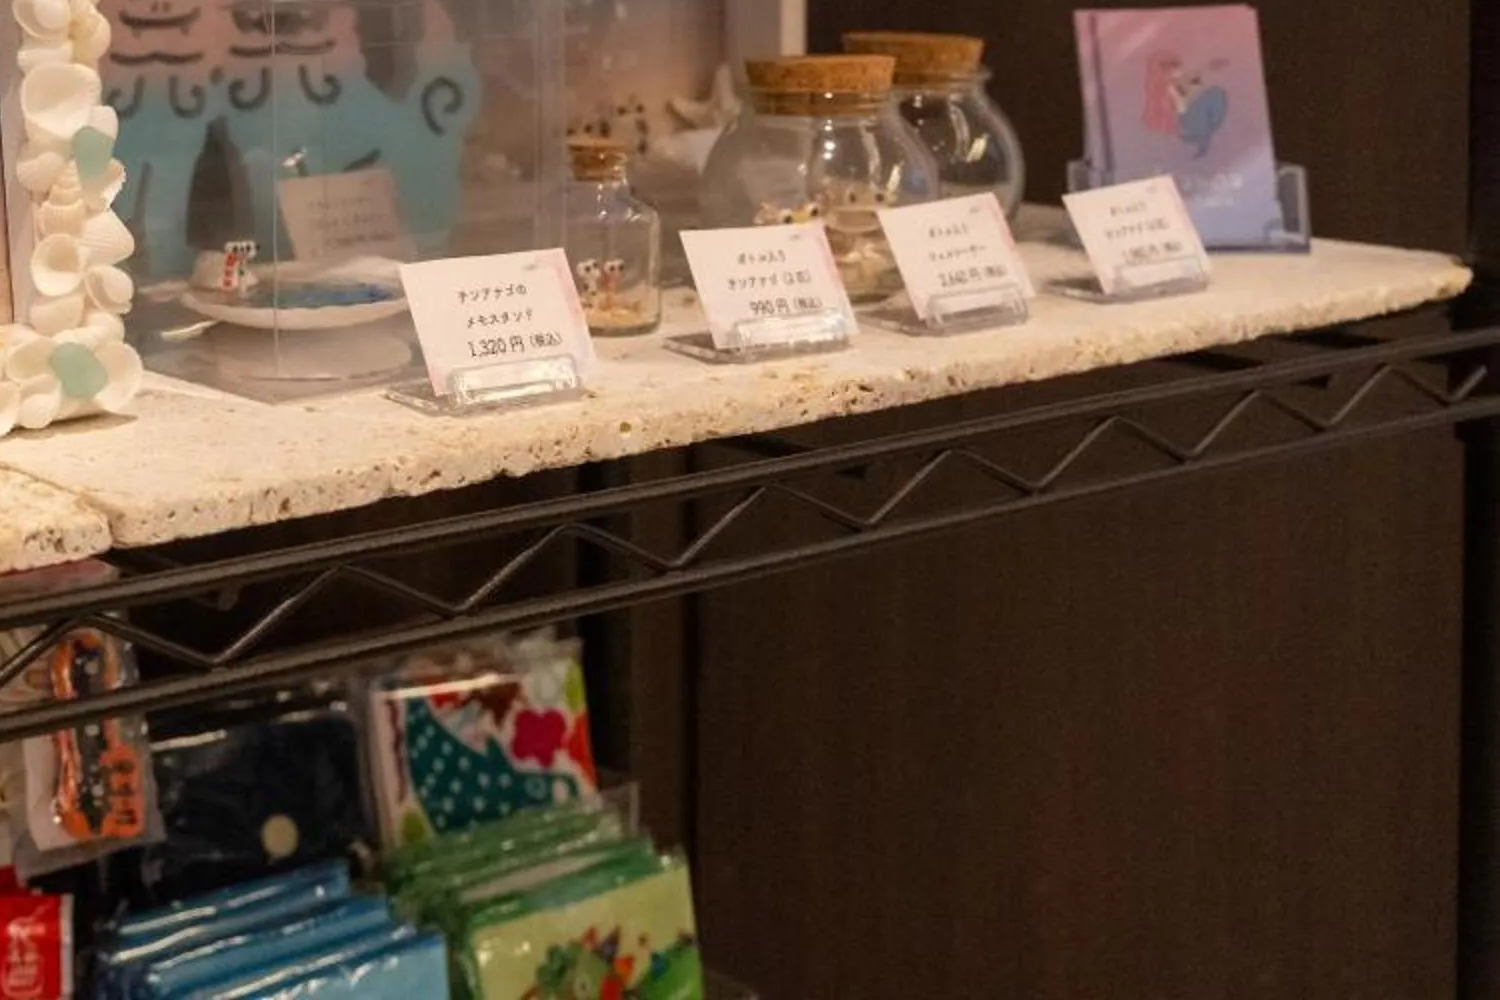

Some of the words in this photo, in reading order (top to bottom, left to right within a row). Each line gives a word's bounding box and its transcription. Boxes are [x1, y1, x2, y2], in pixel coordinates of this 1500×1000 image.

[458, 283, 528, 304] チンアナゴの
[467, 307, 533, 329] メモスタンド
